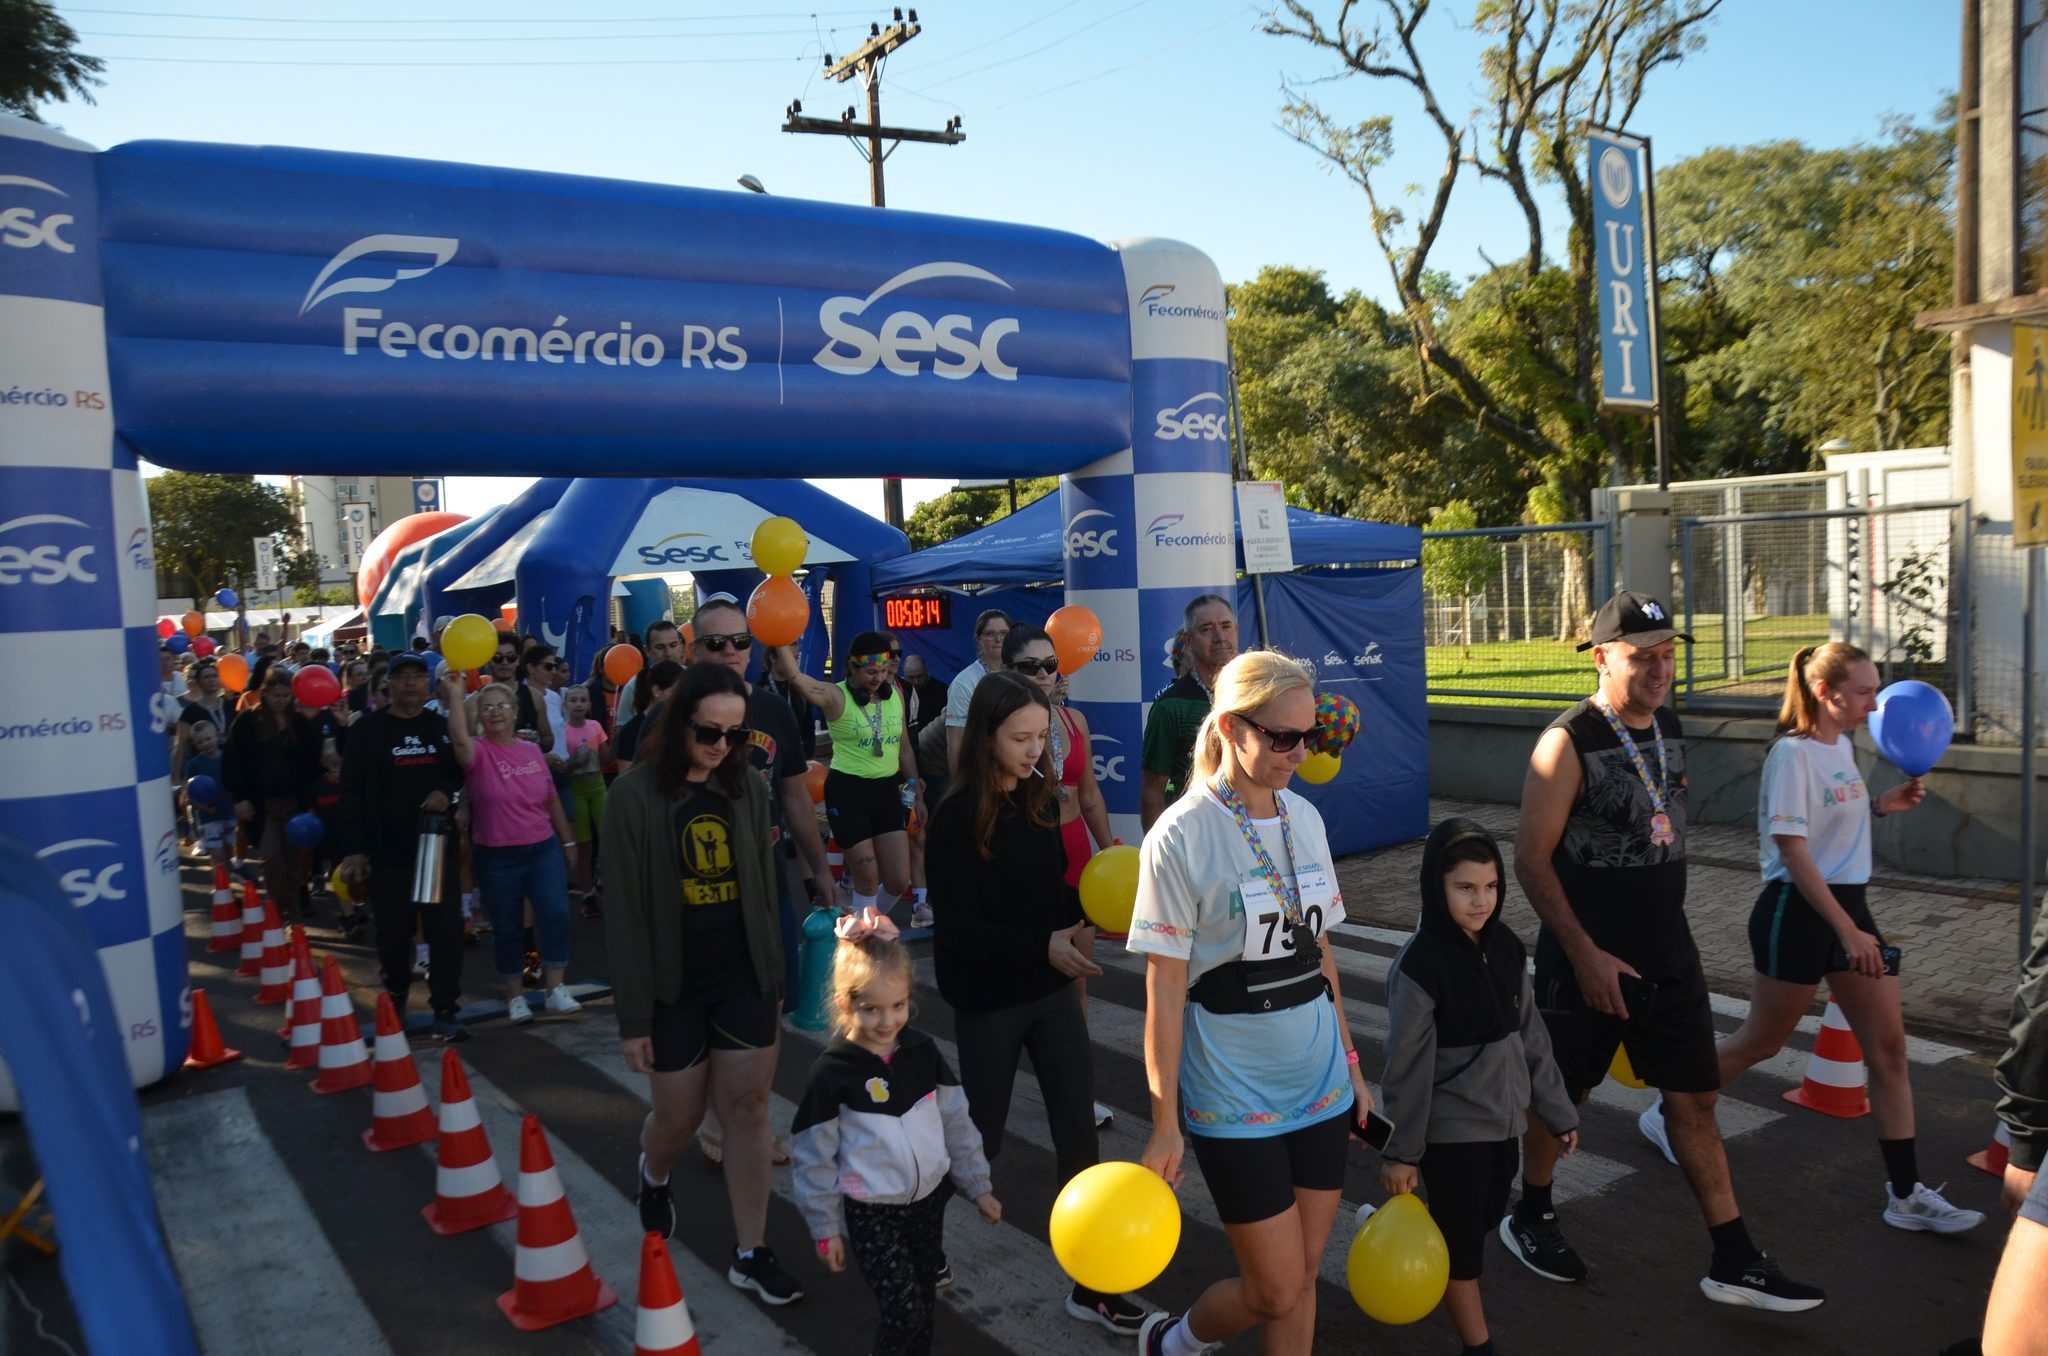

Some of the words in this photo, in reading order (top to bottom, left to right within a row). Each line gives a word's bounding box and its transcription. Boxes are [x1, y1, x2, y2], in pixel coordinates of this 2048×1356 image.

[0, 207, 75, 253] sc
[1148, 304, 1219, 321] Fecomércio
[1605, 220, 1639, 394] URI
[343, 307, 665, 367] Fecomércio
[682, 325, 748, 371] RS
[813, 294, 1020, 381] Sesc
[75, 389, 105, 411] RS
[1155, 532, 1227, 547] Fecomércio
[637, 541, 730, 566] Sesc
[1115, 648, 1136, 662] RS
[99, 712, 127, 732] RS
[1091, 754, 1126, 782] sc
[131, 1019, 157, 1041] RS
[1520, 1232, 1538, 1254] FILA
[1742, 1274, 1766, 1286] FILA
